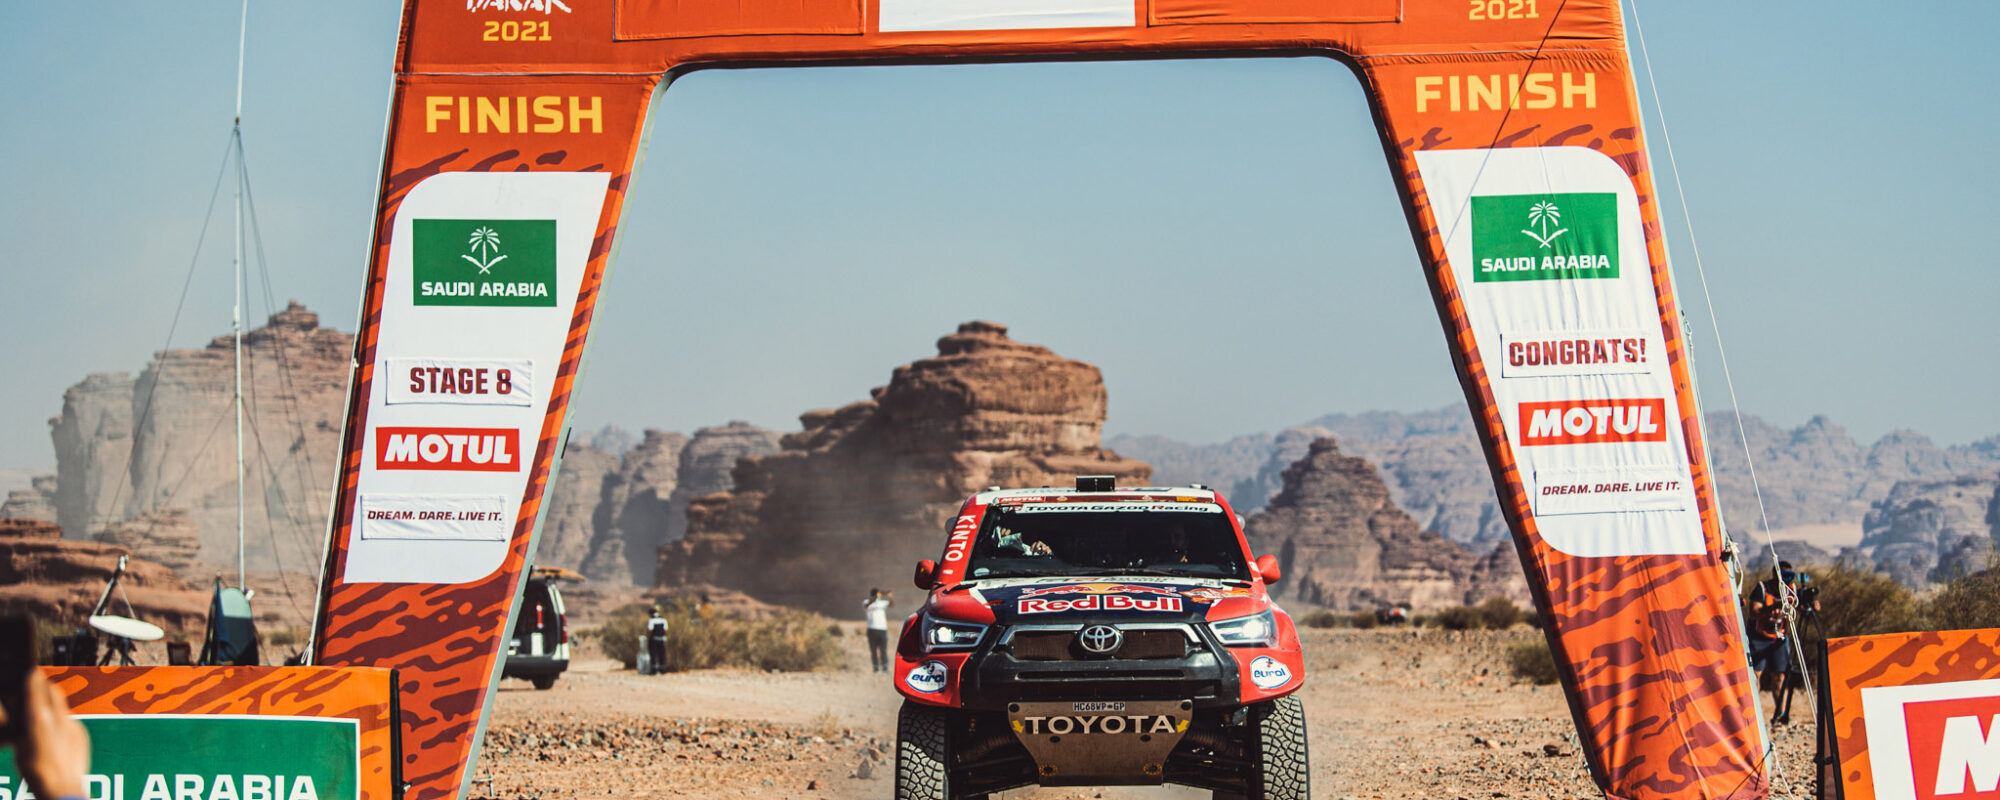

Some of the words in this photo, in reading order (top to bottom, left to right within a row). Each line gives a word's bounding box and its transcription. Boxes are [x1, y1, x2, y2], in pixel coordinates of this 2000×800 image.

[1469, 0, 1540, 20] 2021
[483, 20, 552, 41] 2021
[1415, 72, 1597, 113] FINISH
[426, 95, 603, 134] FINISH
[1481, 256, 1536, 273] SAUDI
[1540, 254, 1610, 271] ARABIA
[421, 281, 475, 296] SAUDI
[479, 282, 548, 297] ARABIA
[1509, 338, 1646, 367] CONGRATS!
[410, 367, 488, 394] STAGE
[496, 368, 512, 395] 8
[1527, 405, 1658, 438] MOTUL
[384, 433, 512, 464] MOTUL
[1542, 483, 1591, 496] DREAM.
[1594, 482, 1632, 493] DARE.
[1635, 481, 1663, 492] LIVE
[1666, 480, 1681, 491] IT.
[367, 510, 416, 521] DREAM.
[418, 510, 455, 521] DARE.
[458, 511, 485, 521] LIVE
[488, 512, 502, 521] IT.
[1151, 504, 1209, 512] Racing
[1018, 594, 1099, 613] Red
[1104, 594, 1183, 612] Bull
[1254, 668, 1286, 678] eurol
[1025, 715, 1175, 735] TOYOTA
[141, 774, 320, 800] ARABIA
